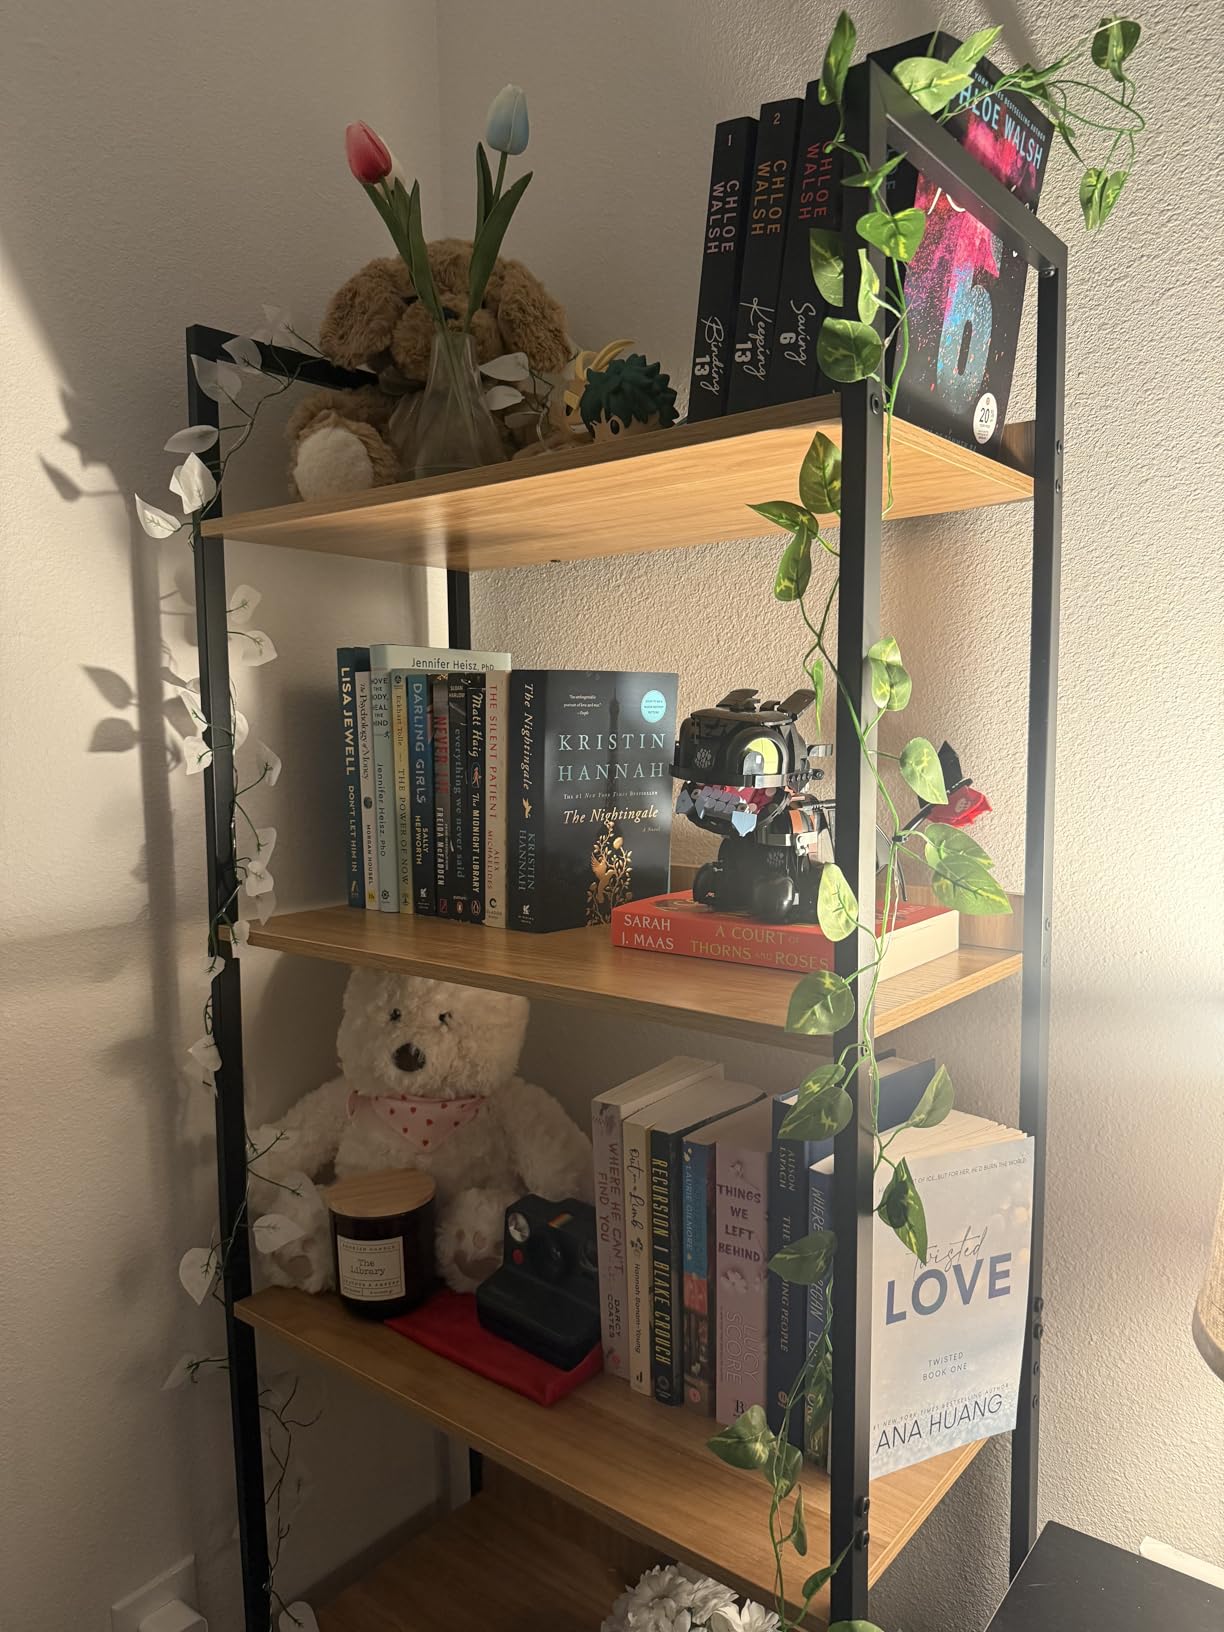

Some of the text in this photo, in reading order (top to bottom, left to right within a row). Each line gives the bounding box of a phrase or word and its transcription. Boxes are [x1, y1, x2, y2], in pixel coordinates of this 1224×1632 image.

[727, 133, 732, 147] 1
[773, 112, 781, 125] 2
[958, 85, 1043, 170] HLOE WALSH
[751, 160, 771, 236] WALSH
[767, 159, 787, 235] CHLOE
[798, 142, 820, 220] WALSH
[706, 181, 726, 254] WALSH
[721, 179, 740, 253] CHLOE
[734, 340, 753, 363] 13
[739, 297, 775, 381] Keeping
[779, 332, 796, 345] 6
[783, 299, 817, 366] Saving
[694, 354, 711, 376] 13
[699, 315, 725, 396] Binding
[978, 407, 990, 424] 20
[372, 677, 389, 685] OVE
[411, 657, 495, 671] Jennifer Heisz, PhD
[373, 693, 389, 701] ODY,
[341, 667, 356, 776] LISA JEWELL
[360, 694, 369, 746] Psychology
[373, 719, 389, 727] IND
[434, 716, 448, 764] NEVER
[469, 692, 484, 758] Matt Haig
[520, 683, 534, 790] The Nightingale
[558, 732, 667, 752] KRISTIN
[361, 749, 371, 782] Money
[413, 682, 427, 804] DARLING GIRLS
[489, 686, 498, 818] THE SILENT PATIENT
[558, 762, 665, 782] HANNAH
[399, 797, 407, 836] POWER
[454, 729, 465, 878] everything we never said
[563, 804, 659, 825] The Nightingale
[347, 784, 358, 873] DON'T LET HIM IN
[400, 838, 407, 856] OF
[415, 815, 423, 865] HEPWORTH
[436, 807, 445, 886] FREIDA McFADDEN
[471, 792, 480, 893] The MIDNIGHT LIBRARY
[400, 857, 408, 886] NOW
[518, 830, 527, 890] HANNAH
[527, 832, 536, 889] KRISTIN
[621, 932, 674, 950] J. MAAS
[623, 914, 671, 931] SARAH
[715, 926, 725, 937] A
[731, 927, 785, 945] COURT
[690, 940, 752, 960] THORNS
[775, 951, 829, 970] ROSES
[607, 1143, 621, 1197] WHERE
[787, 1149, 796, 1192] ALISON
[998, 1161, 1008, 1169] THE
[598, 1171, 610, 1243] FIND YOU
[610, 1201, 622, 1222] HE
[685, 1165, 694, 1250] LAURIE GILMORE
[717, 1183, 762, 1204] THINGS
[730, 1205, 749, 1220] WE
[811, 1187, 825, 1235] WHERE
[610, 1227, 625, 1276] CAN'T
[724, 1223, 755, 1240] LEFT
[782, 1216, 791, 1242] THE
[351, 1264, 386, 1276] Library
[652, 1158, 671, 1366] RECURSION BLAKE CROUCH
[718, 1241, 761, 1263] BEHIND
[633, 1263, 641, 1297] Hannah
[886, 1252, 1012, 1325] LOVE
[607, 1293, 616, 1339] COATES
[614, 1298, 622, 1337] DARCY
[634, 1298, 642, 1354] Bonam-Young
[780, 1308, 790, 1353] PEOPLE
[726, 1310, 743, 1385] SCORE
[743, 1323, 761, 1385] LUCY
[928, 1351, 964, 1367] TWISTED
[922, 1362, 967, 1381] BOOK ONE
[876, 1393, 1003, 1455] ANA HUANG
[883, 1417, 899, 1426] NEW
[900, 1412, 917, 1423] YORK
[920, 1405, 939, 1415] TIMES
[941, 1391, 983, 1408] BESTSELLING
[984, 1382, 1010, 1395] AUTHOR
